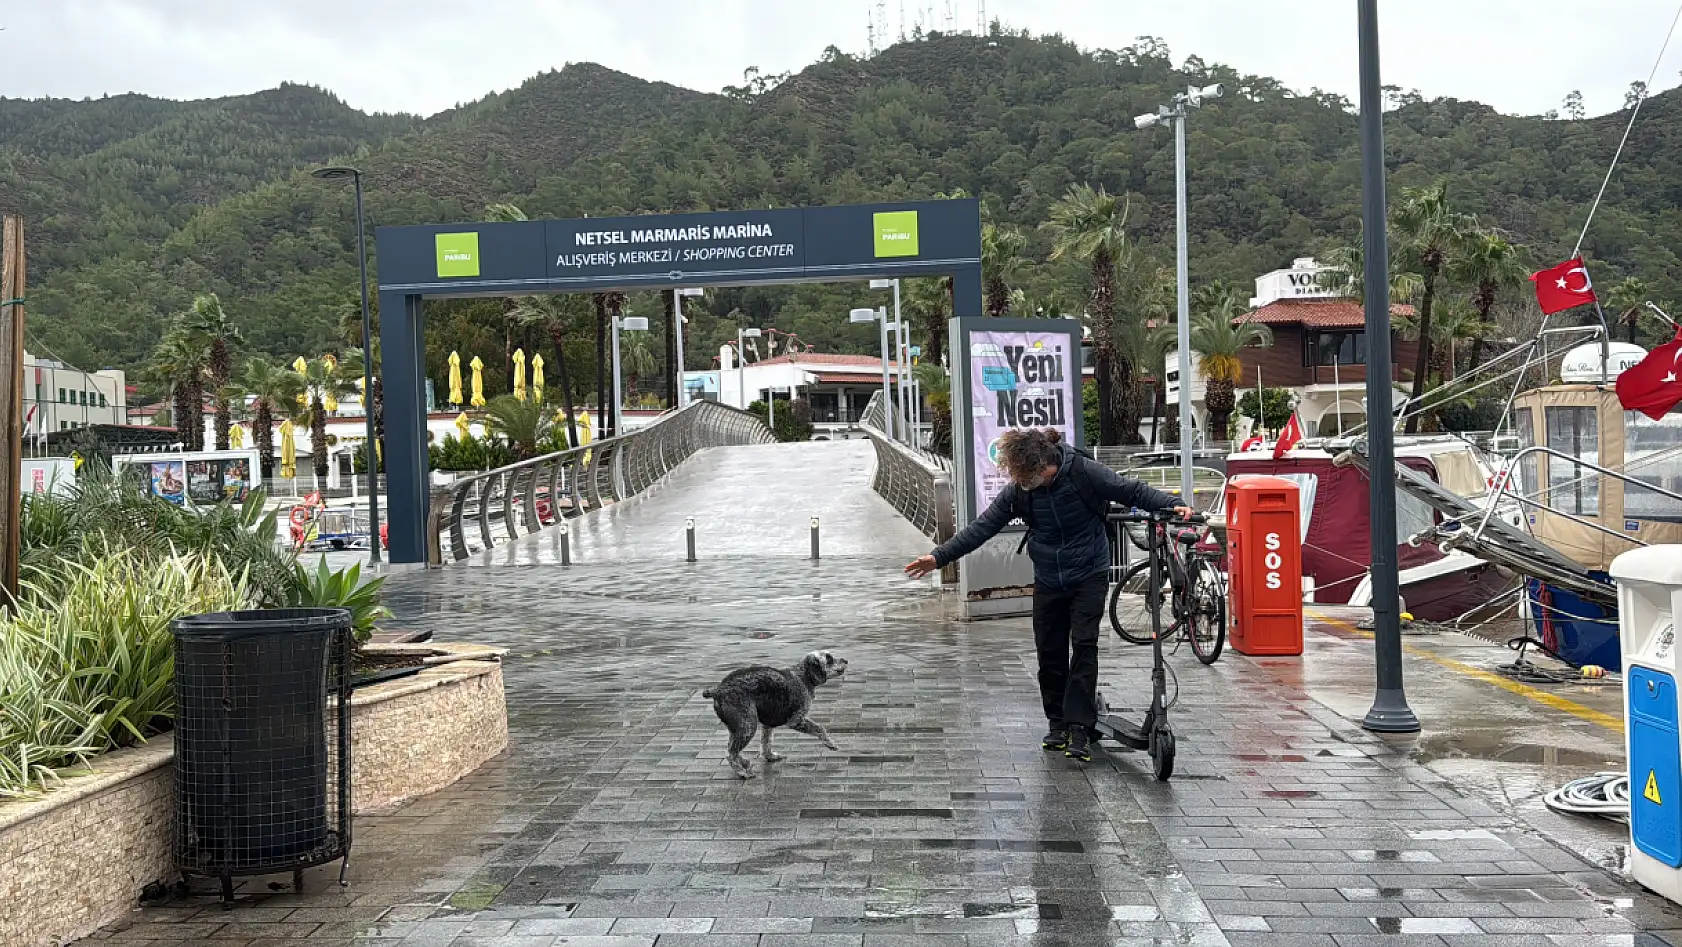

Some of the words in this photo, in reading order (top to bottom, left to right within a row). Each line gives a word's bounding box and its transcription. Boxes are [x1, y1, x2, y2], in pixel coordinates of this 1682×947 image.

[575, 231, 629, 247] NETSEL
[631, 224, 711, 244] MARMARİS
[713, 221, 773, 240] MARİNA
[556, 250, 617, 269] ALIŞVERİŞ
[619, 248, 673, 265] MERKEZİ
[683, 246, 746, 261] SHOPPING
[748, 243, 794, 258] CENTER
[1003, 345, 1064, 383] Yeni
[996, 388, 1066, 428] Nesil
[1265, 532, 1282, 589] SOS
